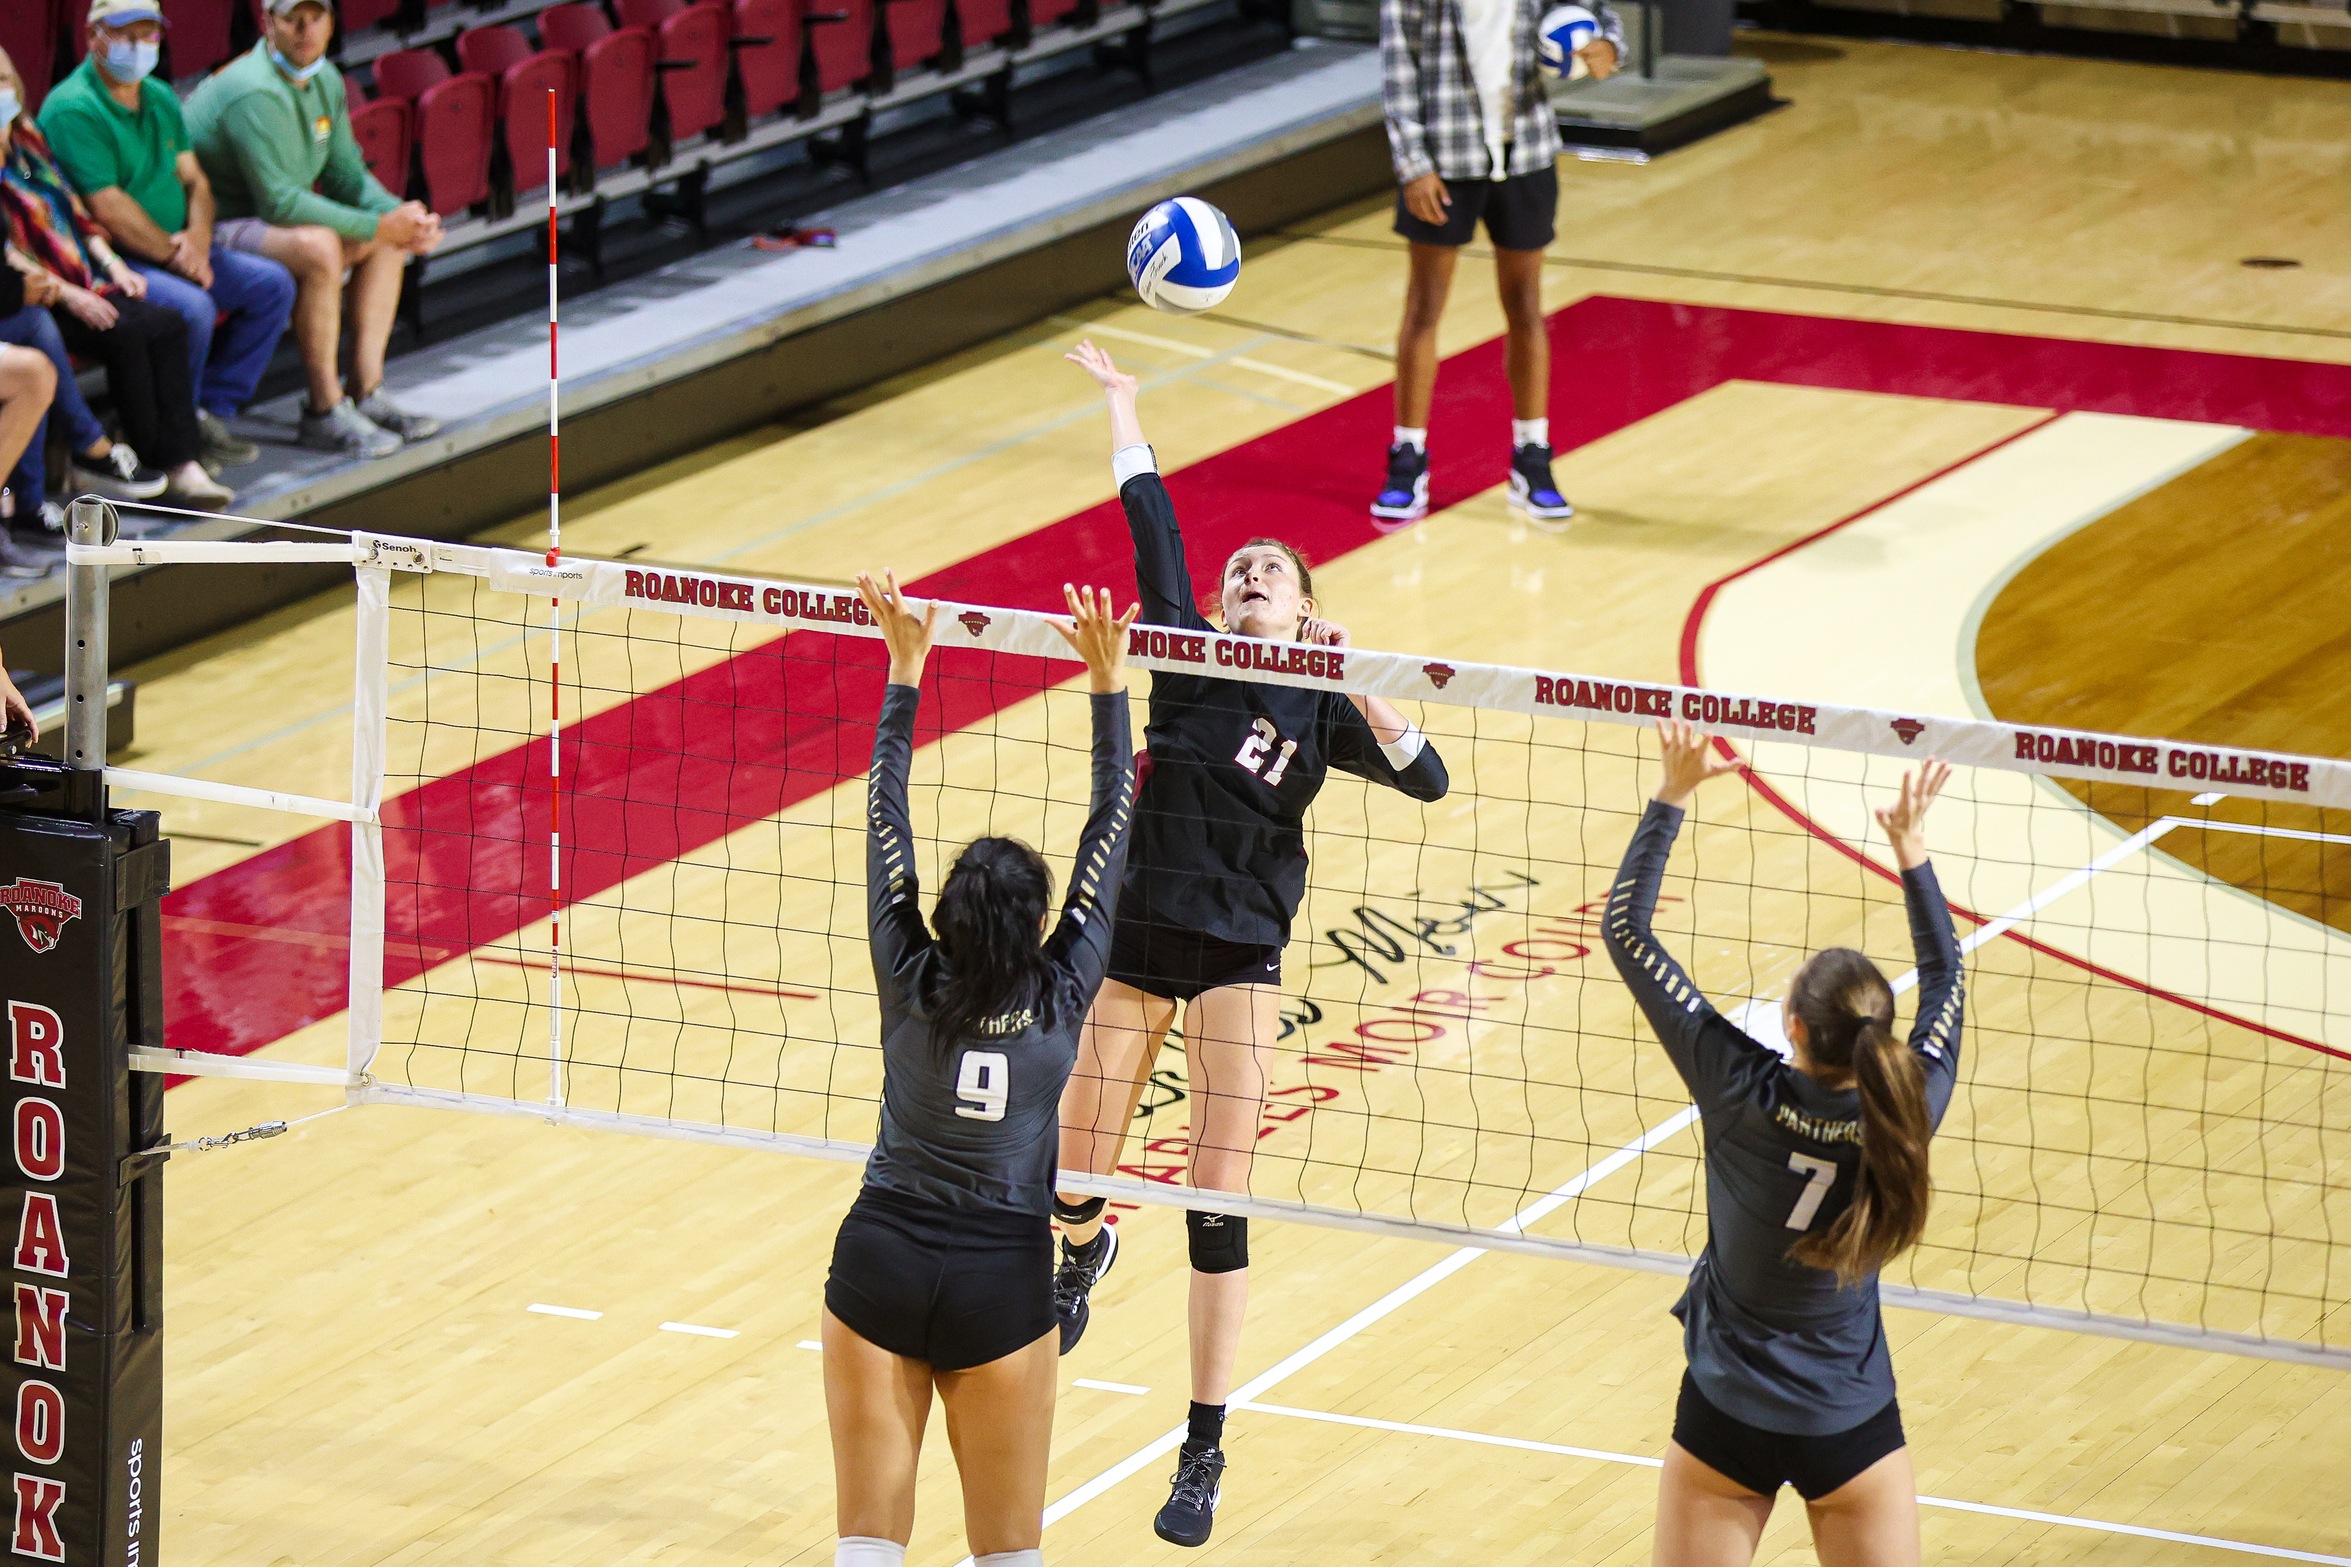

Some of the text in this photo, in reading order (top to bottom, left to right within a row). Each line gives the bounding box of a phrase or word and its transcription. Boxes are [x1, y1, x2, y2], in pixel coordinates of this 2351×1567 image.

[382, 542, 417, 553] Senoh
[529, 567, 553, 578] sports
[625, 570, 754, 612] ROANOKE
[1127, 628, 1344, 680] NOKE COLLEGE
[1535, 675, 1816, 735] ROANOKE COLLEGE
[1233, 716, 1298, 787] 21
[2015, 732, 2310, 791] ROANOKE COLLEGE
[0, 886, 82, 916] ROANOKE
[15, 904, 64, 919] MAROONS
[1299, 989, 1507, 1072] MOIR
[955, 1050, 1009, 1122] 9
[1784, 1151, 1838, 1232] 7
[7, 999, 69, 1563] ROANOK
[127, 1438, 143, 1538] sports
